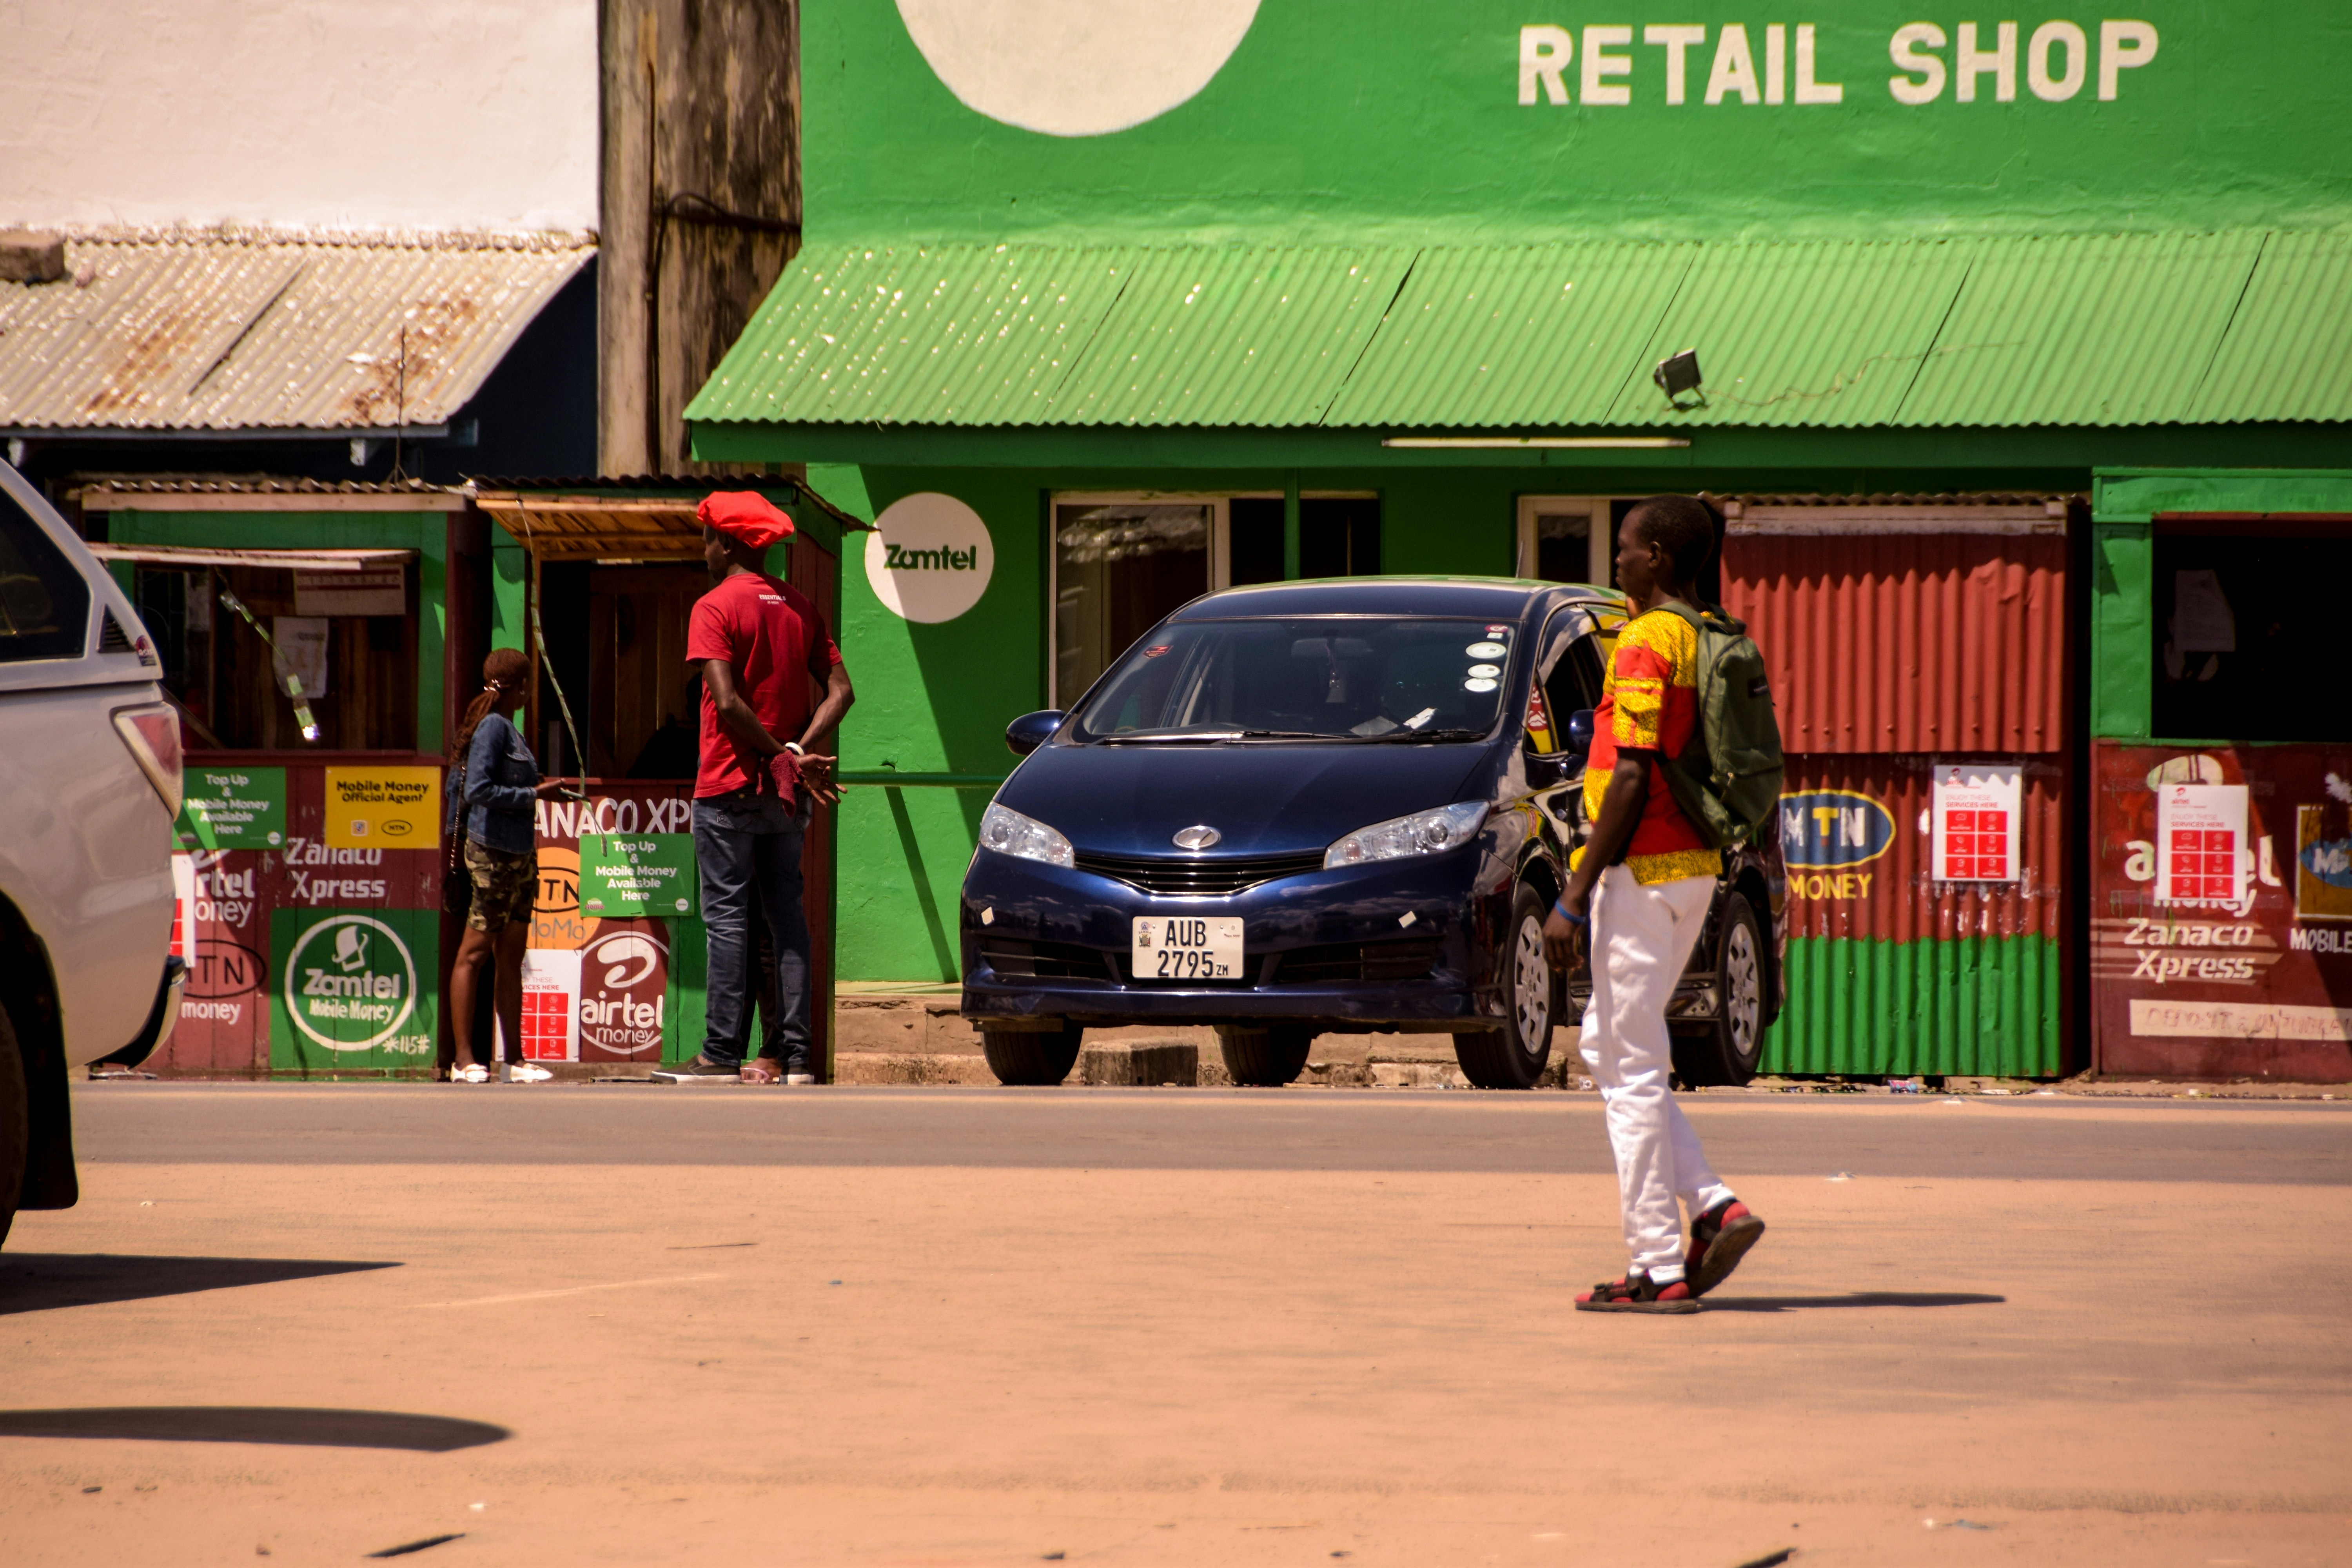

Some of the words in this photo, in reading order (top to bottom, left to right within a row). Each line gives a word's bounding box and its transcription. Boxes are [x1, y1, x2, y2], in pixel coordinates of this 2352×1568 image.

[1518, 23, 1844, 105] RETAIL
[1888, 18, 2159, 105] SHOP
[883, 544, 976, 570] Zamtel
[205, 773, 229, 786] Top
[230, 773, 249, 787] Up
[337, 780, 381, 791] Mobile
[385, 780, 429, 794] Money
[187, 798, 228, 809] Mobile
[229, 799, 269, 811] Money
[342, 792, 385, 802] Official
[387, 793, 423, 804] Agent
[199, 810, 254, 822] Available
[214, 823, 243, 834] Here
[534, 798, 638, 838] ANACO
[1785, 806, 1865, 847] MTN
[286, 838, 382, 865] Zanaco
[613, 841, 637, 853] Top
[639, 841, 656, 853] Up
[630, 853, 639, 864] &
[196, 868, 255, 898] rtel
[595, 865, 634, 877] Mobile
[637, 866, 677, 878] Money
[607, 877, 661, 889] Available
[291, 870, 385, 905] Xpress
[622, 890, 650, 900] Here
[1788, 873, 1873, 900] MONEY
[194, 900, 252, 928] oney
[1165, 919, 1206, 946] AUB
[2124, 917, 2255, 946] Zanaco
[2290, 927, 2352, 953] MOBILE
[186, 956, 243, 984] TN
[1158, 949, 1213, 977] 2795
[1216, 964, 1228, 975] ZM
[2131, 949, 2256, 983] Xpress
[303, 968, 400, 999] Zamtel
[181, 1002, 241, 1025] money
[309, 998, 348, 1018] Mobile
[349, 1000, 395, 1025] Money
[581, 991, 663, 1029] airtel
[596, 1027, 654, 1044] money
